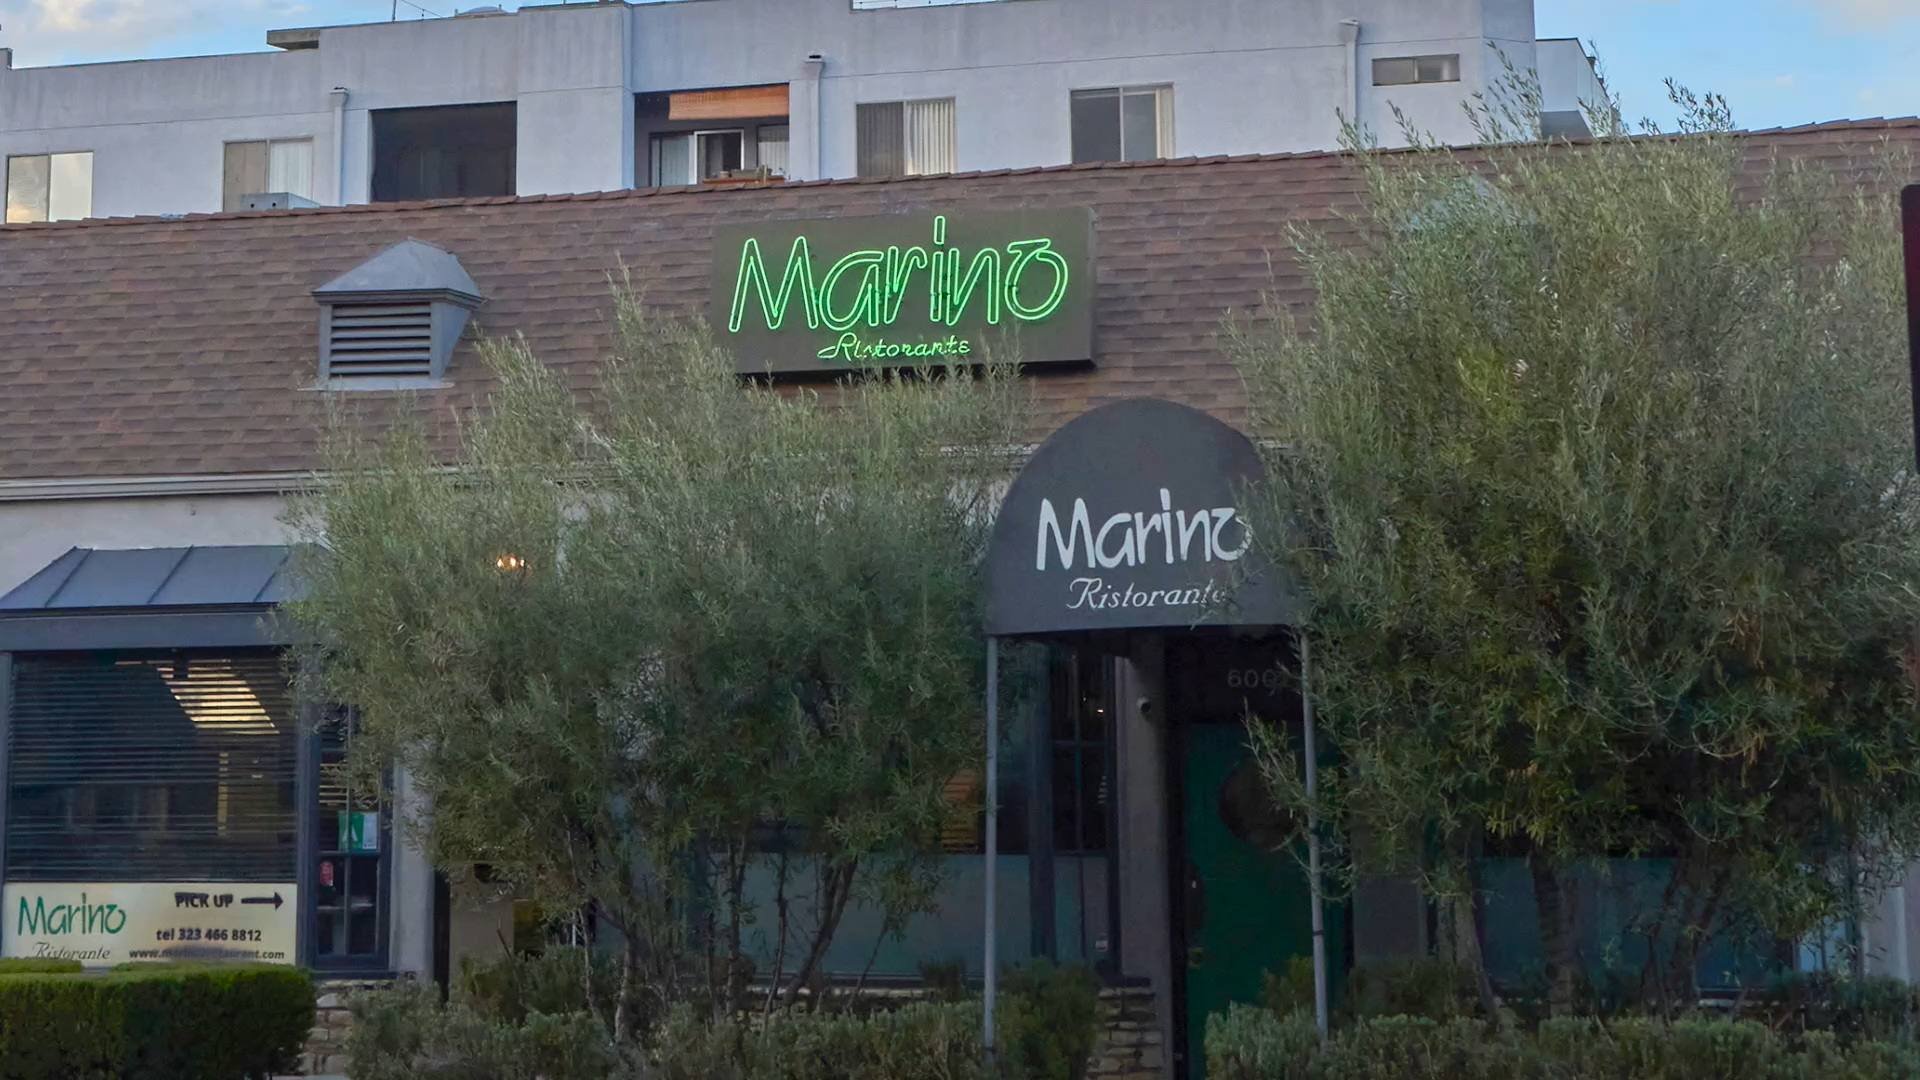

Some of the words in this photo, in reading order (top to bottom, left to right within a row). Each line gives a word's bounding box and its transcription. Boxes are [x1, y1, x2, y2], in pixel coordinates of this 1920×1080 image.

[728, 215, 1069, 333] Marino
[816, 332, 970, 362] Ristorante
[1036, 487, 1252, 571] Marino
[18, 892, 127, 936] Marino
[175, 892, 210, 908] PICK
[213, 894, 234, 908] UP
[156, 928, 175, 941] tel
[178, 929, 202, 941] 323
[204, 930, 229, 941] 466
[231, 930, 262, 942] 8812
[33, 941, 111, 960] Ristorante
